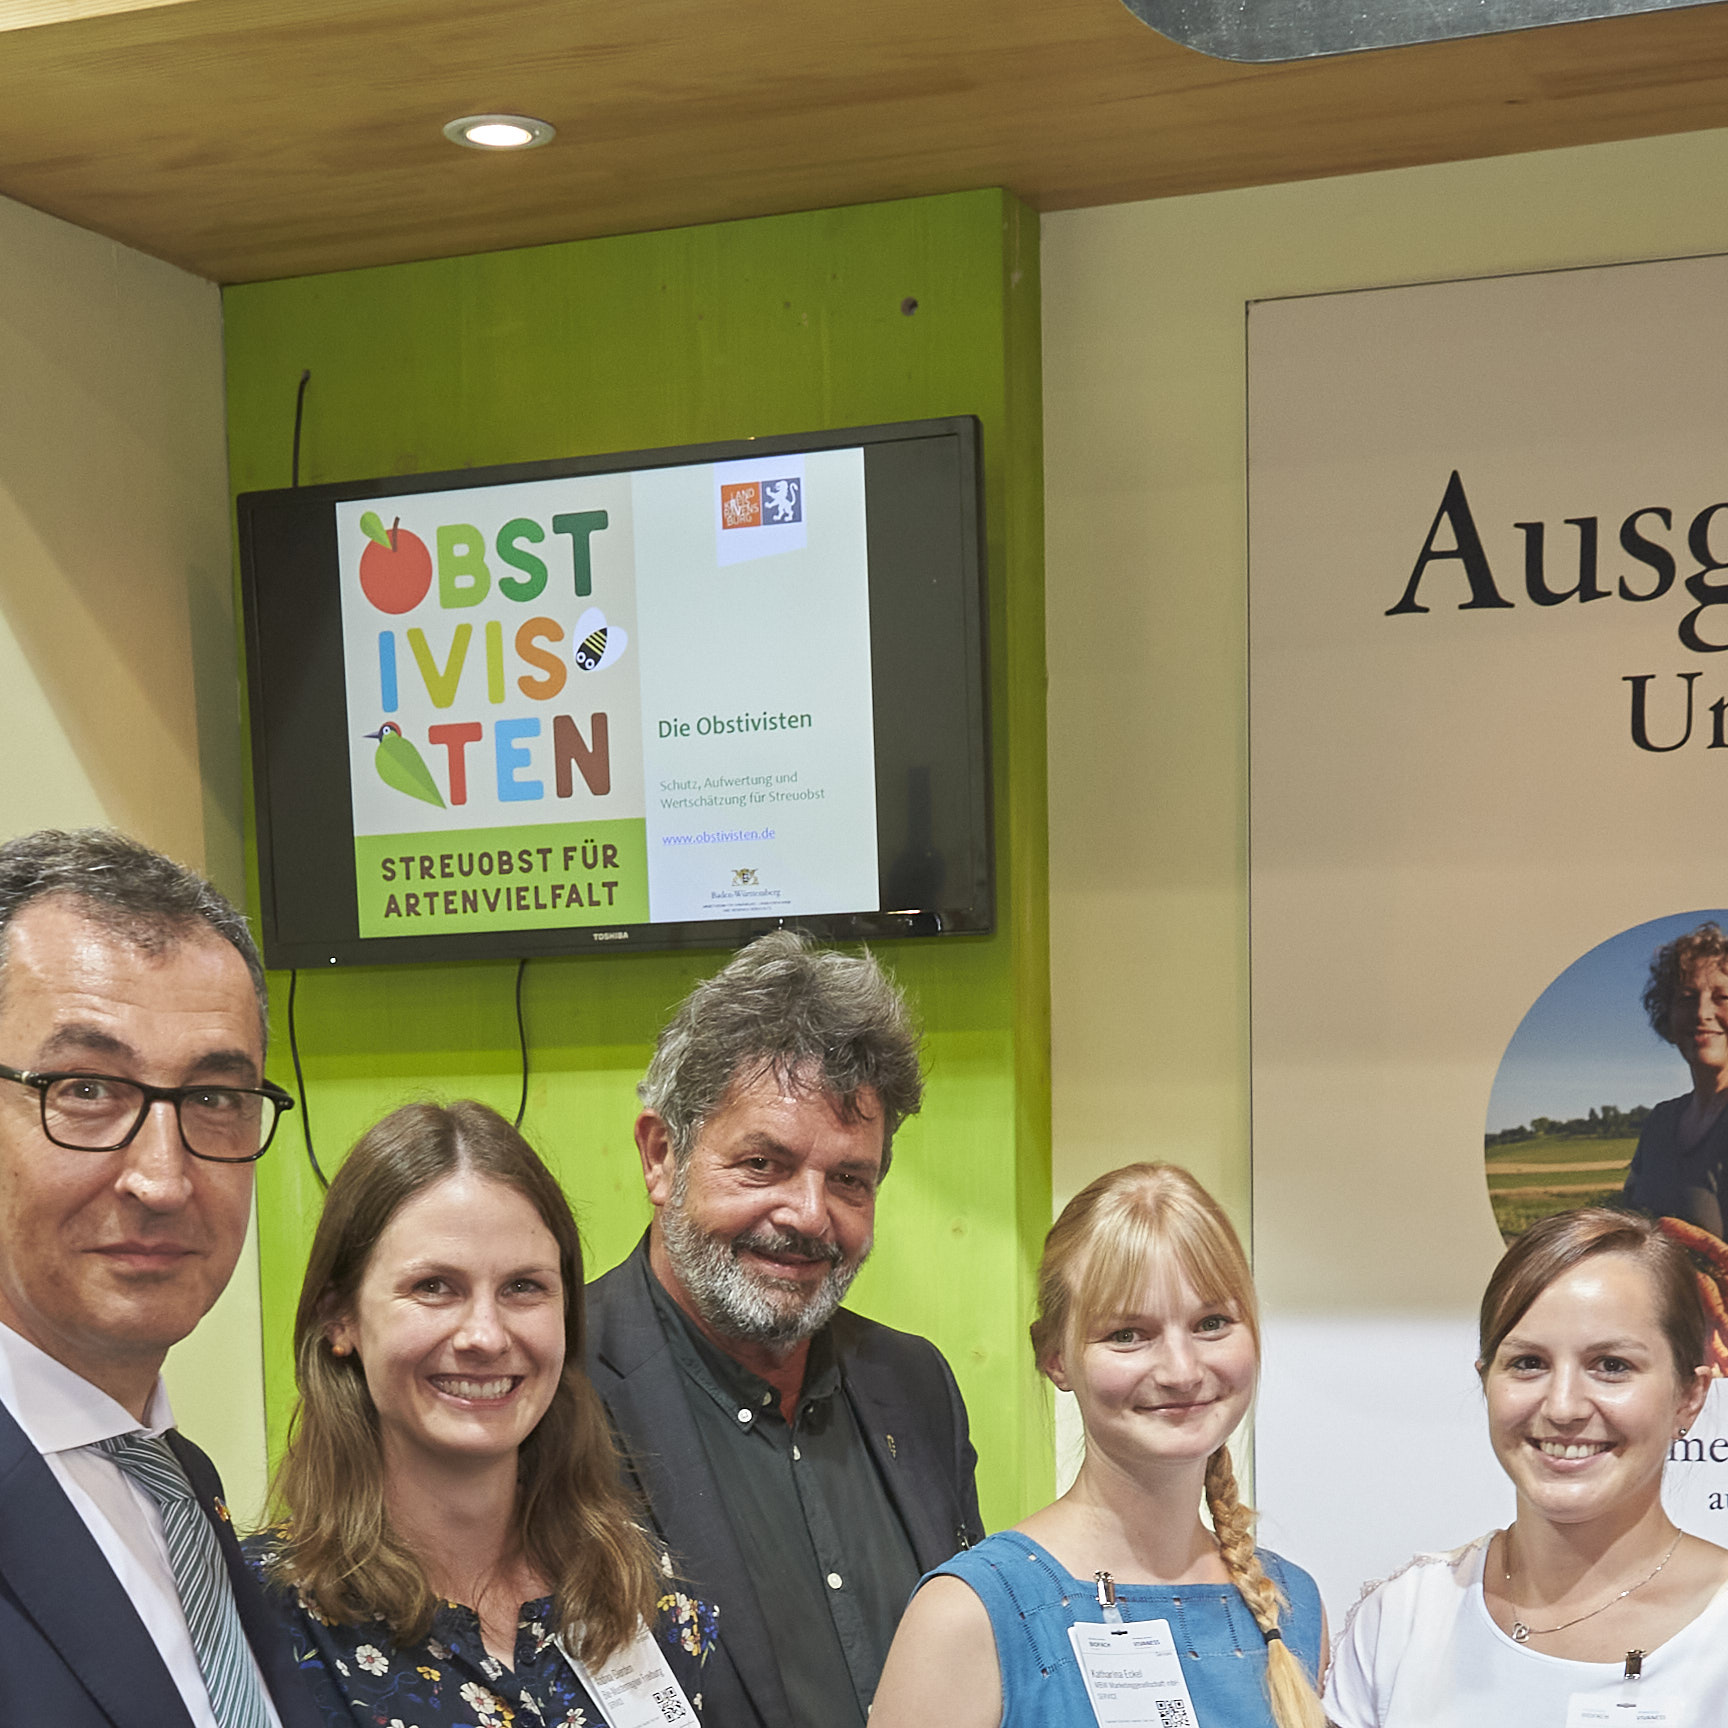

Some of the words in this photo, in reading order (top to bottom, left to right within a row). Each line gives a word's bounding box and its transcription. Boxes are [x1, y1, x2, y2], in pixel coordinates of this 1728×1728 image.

[658, 718, 691, 738] Die
[696, 711, 813, 736] Obstivisten
[660, 778, 702, 792] Schutz,
[704, 774, 773, 789] Aufwertung
[775, 771, 798, 784] und
[660, 794, 747, 810] Wertschätzung
[749, 791, 767, 804] für
[768, 788, 826, 802] Streuobst
[662, 827, 776, 846] www.obstivisten.de
[381, 847, 553, 882] STREUOBST
[562, 838, 620, 872] FÜR
[383, 881, 620, 918] ARTENVIELFALT
